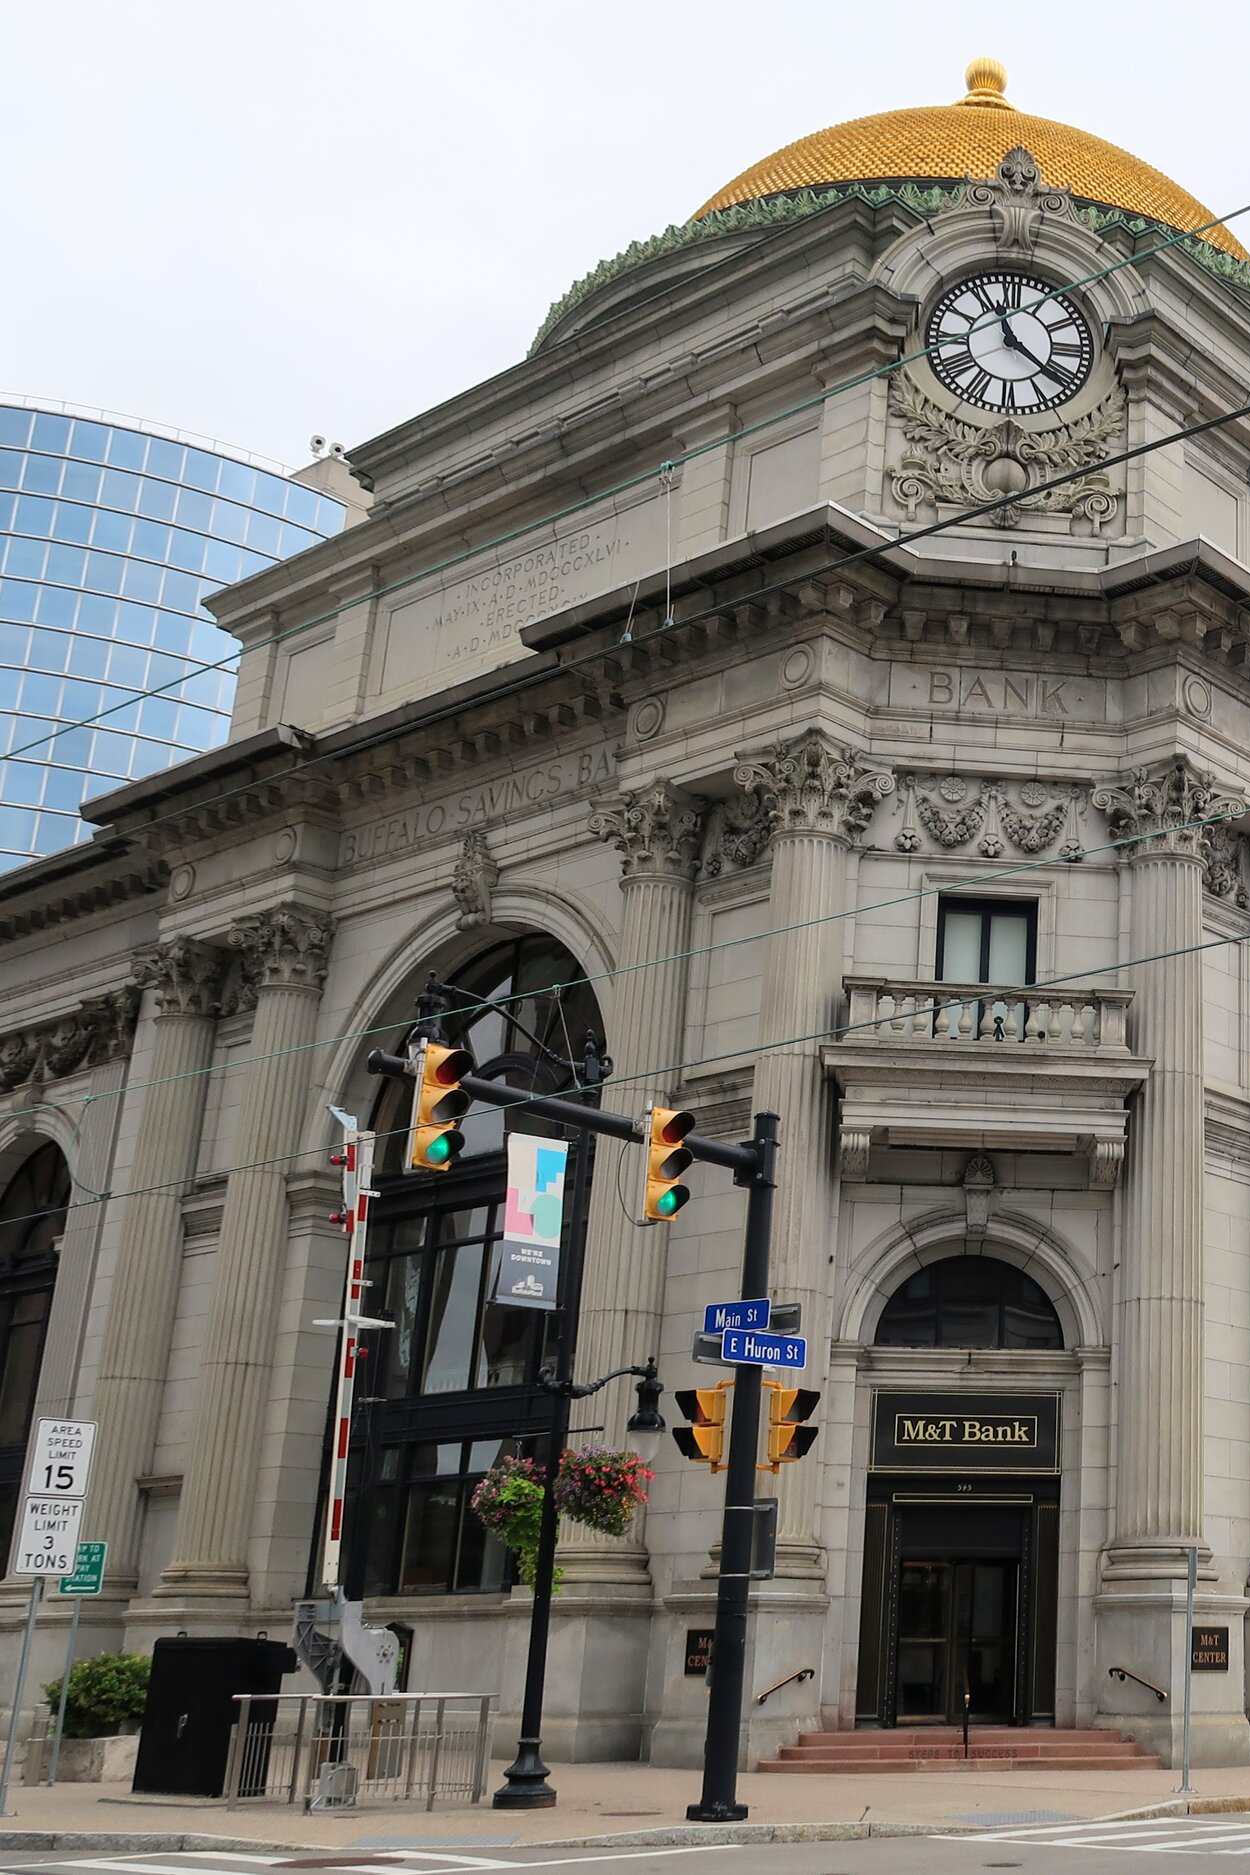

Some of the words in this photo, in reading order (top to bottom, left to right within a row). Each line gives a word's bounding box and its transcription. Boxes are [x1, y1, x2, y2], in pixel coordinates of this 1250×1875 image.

[465, 534, 590, 599] INCORPORATED
[486, 585, 559, 627] ERECTED
[928, 671, 1069, 713] BANK
[342, 806, 446, 863] BUFFALO
[457, 765, 562, 825] SAVINGS
[577, 743, 623, 785] BA
[511, 1254, 552, 1266] DOWNTOWN
[715, 1308, 741, 1328] Main
[747, 1309, 758, 1322] St
[730, 1338, 738, 1352] E
[744, 1336, 780, 1360] Huron
[786, 1345, 798, 1360] St
[51, 1426, 82, 1436] AREA
[902, 1420, 958, 1441] M&T
[962, 1420, 1030, 1442] Bank
[47, 1437, 83, 1448] SPEED
[49, 1450, 77, 1460] LIMIT
[44, 1465, 74, 1490] 15
[30, 1503, 79, 1517] WEIGHT
[34, 1520, 68, 1532] LIMIT
[43, 1536, 54, 1550] 3
[25, 1553, 68, 1569] TONS
[1200, 1634, 1219, 1646] M&T
[1193, 1651, 1226, 1663] CENTER
[908, 1749, 939, 1759] STEPS
[970, 1748, 1018, 1759] SUCCESS
